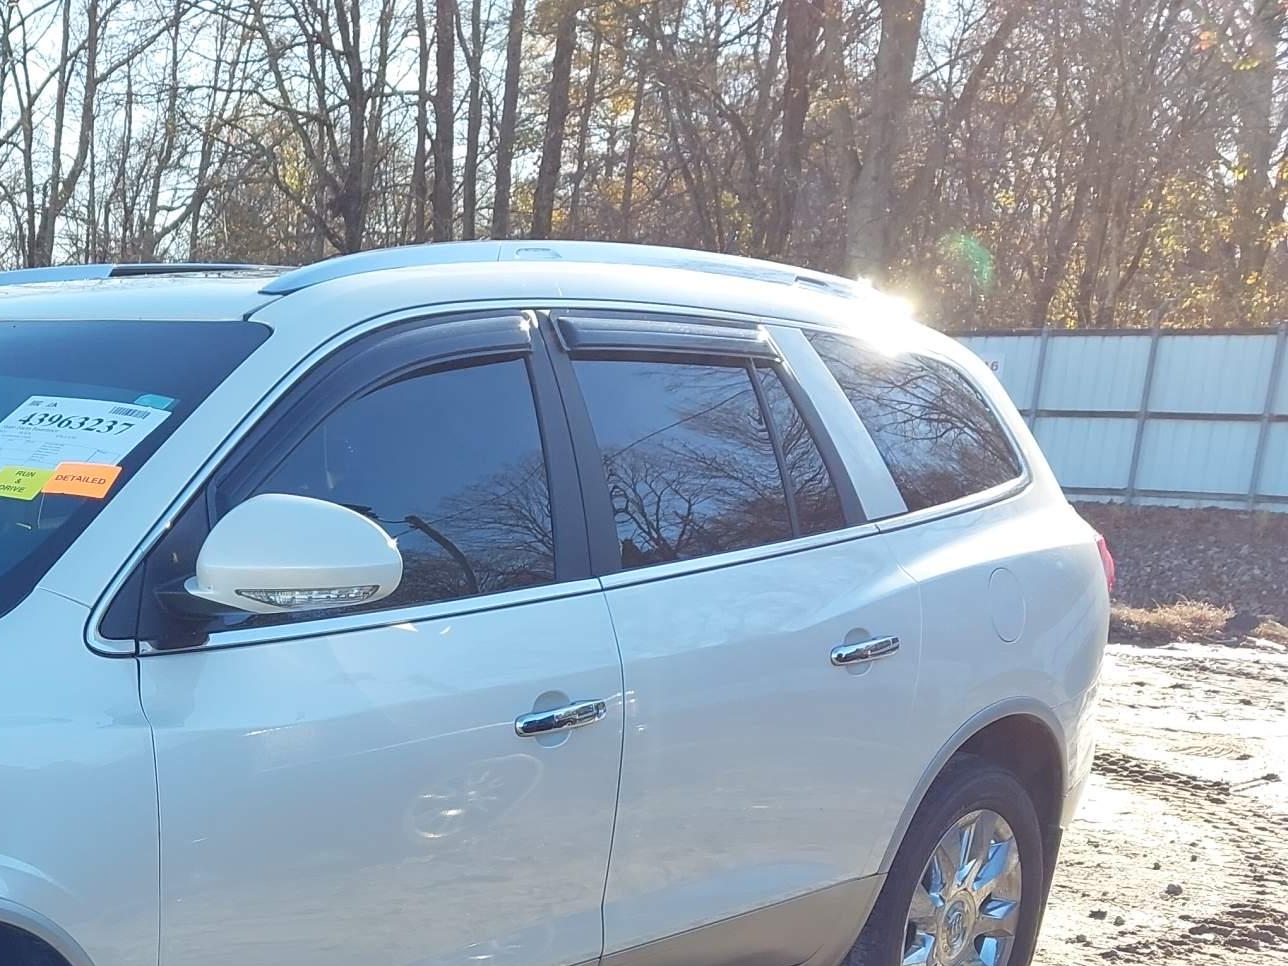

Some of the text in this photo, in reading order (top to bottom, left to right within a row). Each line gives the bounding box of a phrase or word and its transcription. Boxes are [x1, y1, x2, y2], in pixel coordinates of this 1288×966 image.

[18, 412, 135, 436] 43963237
[15, 470, 36, 478] RUN
[55, 474, 107, 485] DETAILED
